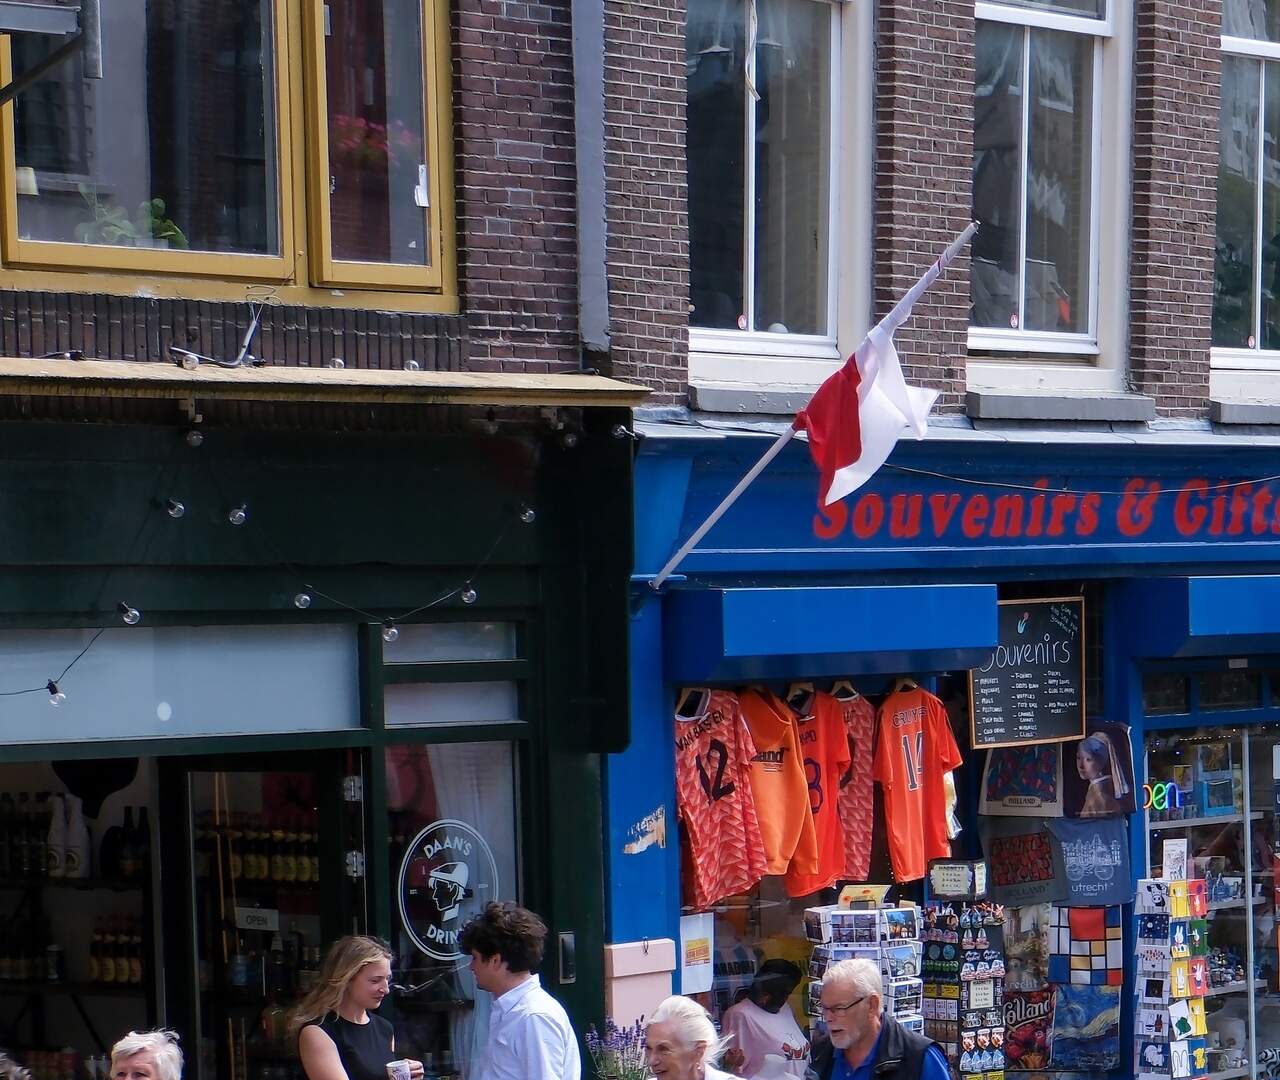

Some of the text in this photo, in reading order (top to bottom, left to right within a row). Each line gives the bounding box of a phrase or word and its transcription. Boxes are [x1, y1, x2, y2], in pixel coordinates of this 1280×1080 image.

[813, 478, 1101, 539] Souvenirs
[1117, 477, 1161, 538] &
[423, 836, 472, 859] DAAN'S
[1071, 882, 1108, 893] utrecht
[426, 924, 465, 945] DRIN
